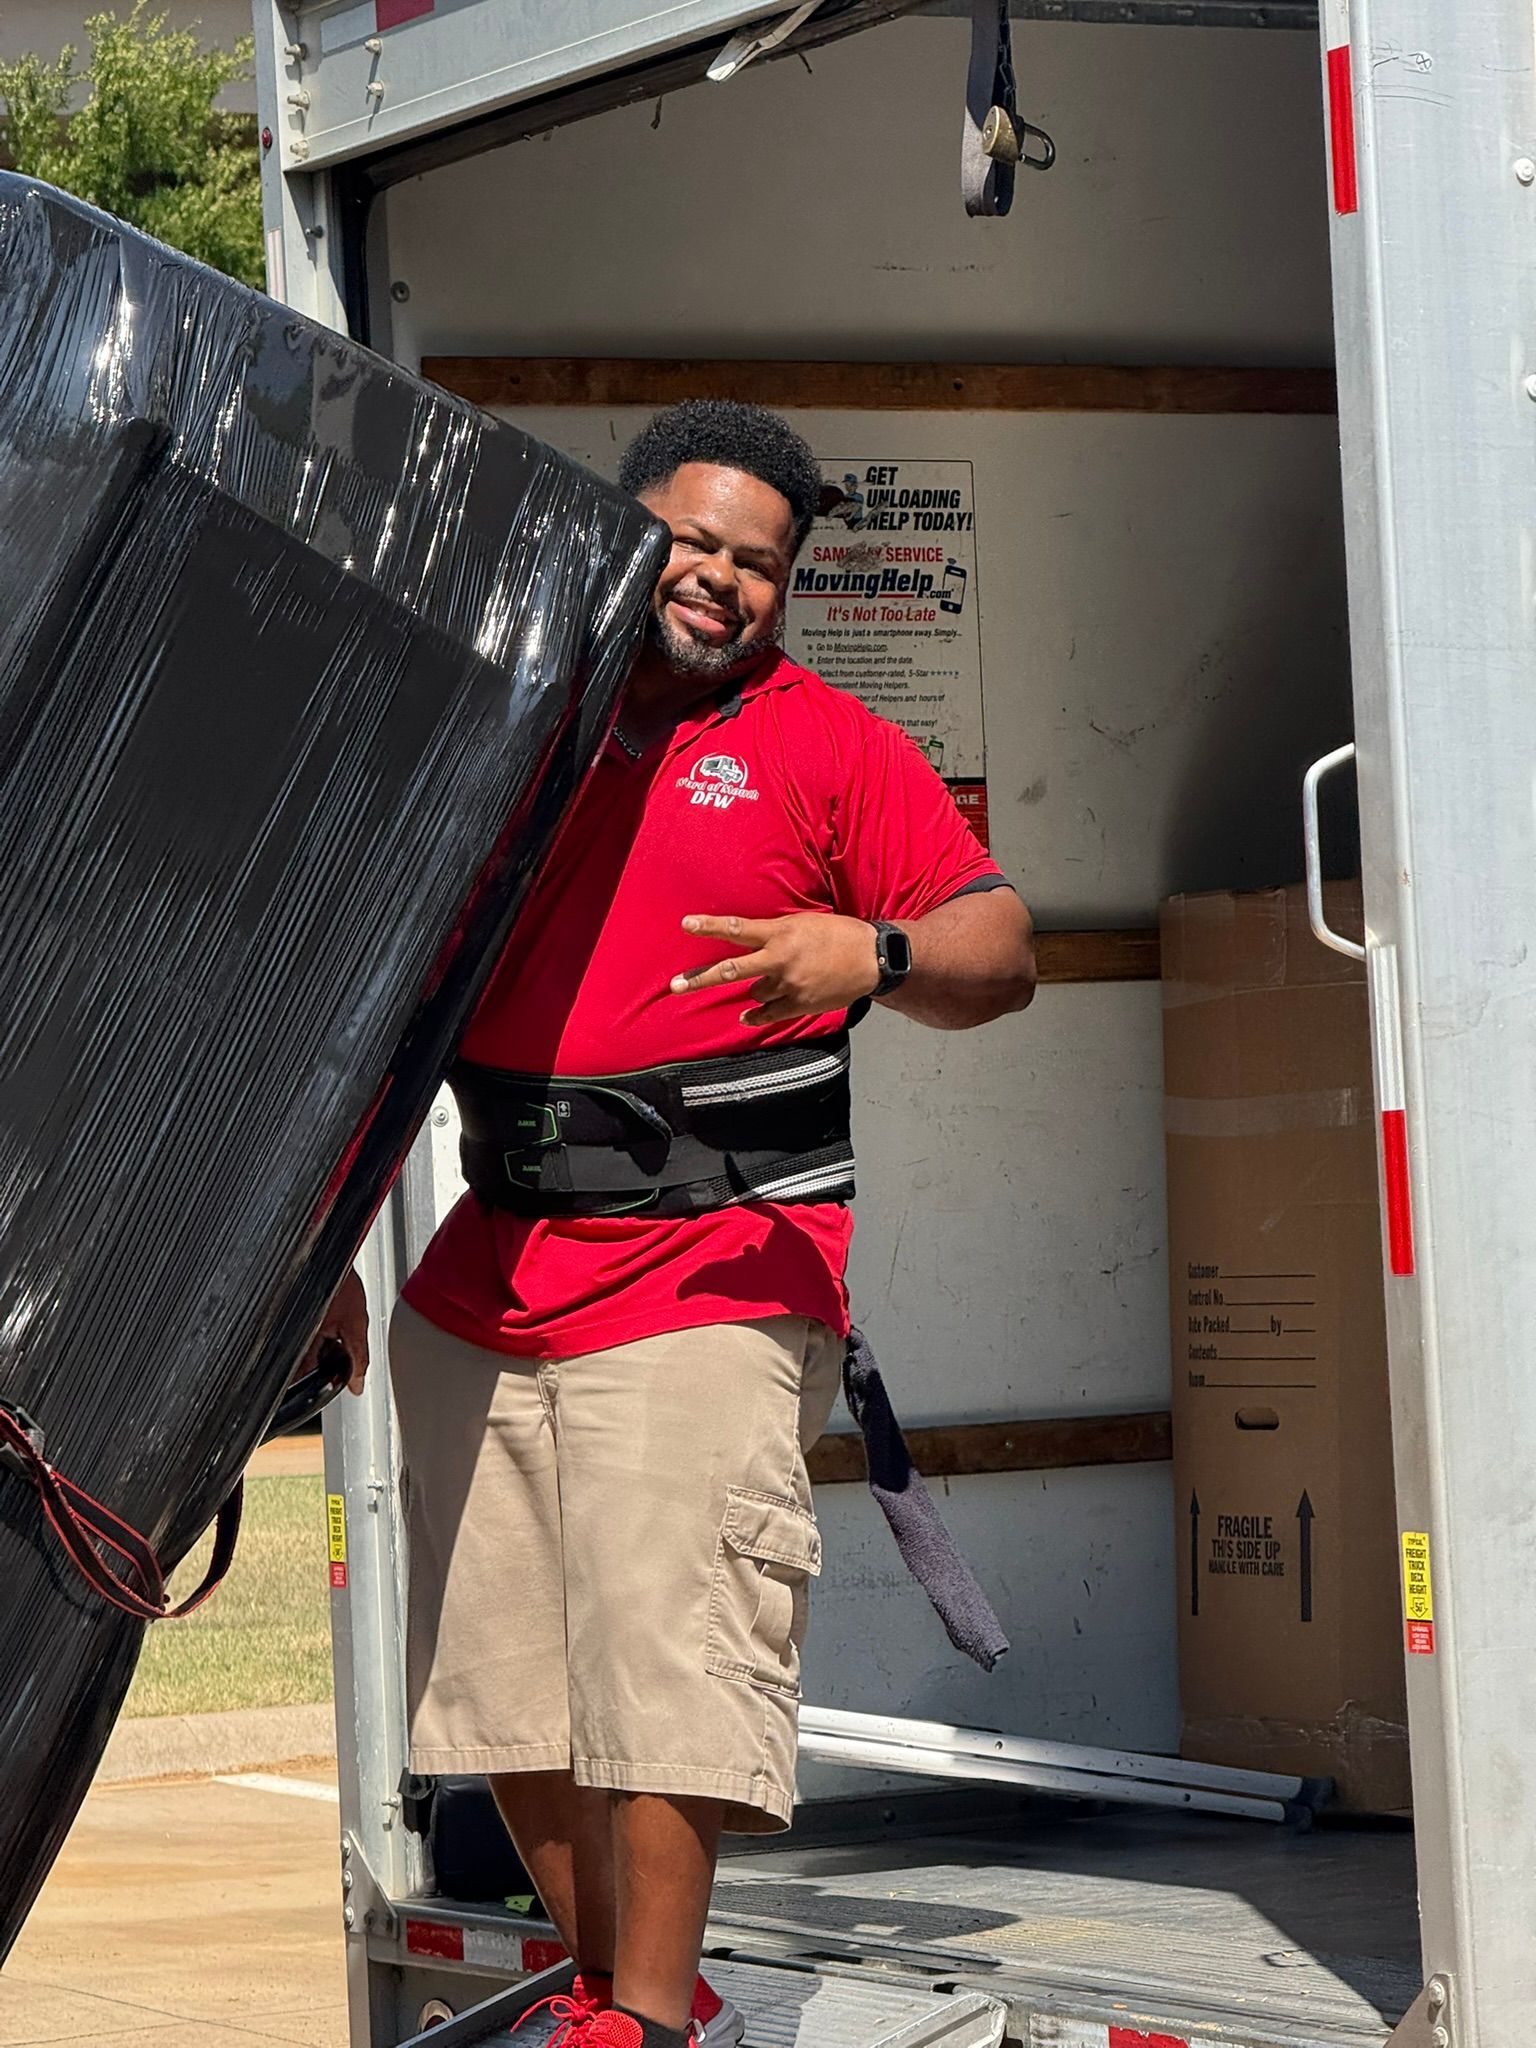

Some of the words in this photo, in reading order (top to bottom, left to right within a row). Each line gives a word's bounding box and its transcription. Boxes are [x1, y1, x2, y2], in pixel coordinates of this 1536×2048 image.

[866, 466, 898, 486] GET
[866, 489, 961, 508] UNLOADING
[866, 512, 909, 531] HELP
[913, 513, 972, 531] TODAY!
[886, 548, 943, 562] SERVICE
[827, 607, 849, 621] It's
[853, 607, 877, 621] Not
[880, 607, 902, 621] Too
[906, 607, 936, 621] Late
[801, 628, 826, 638] Moving
[827, 628, 842, 637] Help
[844, 628, 850, 636] is
[852, 629, 866, 637] just
[873, 629, 913, 637] smartphone
[816, 643, 825, 651] Go
[817, 656, 834, 664] Enter
[847, 656, 872, 664] location
[859, 681, 883, 690] Moving
[690, 790, 736, 809] DFW
[1203, 1315, 1230, 1333] Packed
[1271, 1315, 1281, 1336] by
[1217, 1515, 1273, 1539] FRAGILE
[1212, 1539, 1233, 1558] THIS
[1236, 1540, 1261, 1560] SIDE
[1265, 1541, 1281, 1560] UP
[1239, 1561, 1260, 1576] WITH
[1262, 1562, 1285, 1577] CARE
